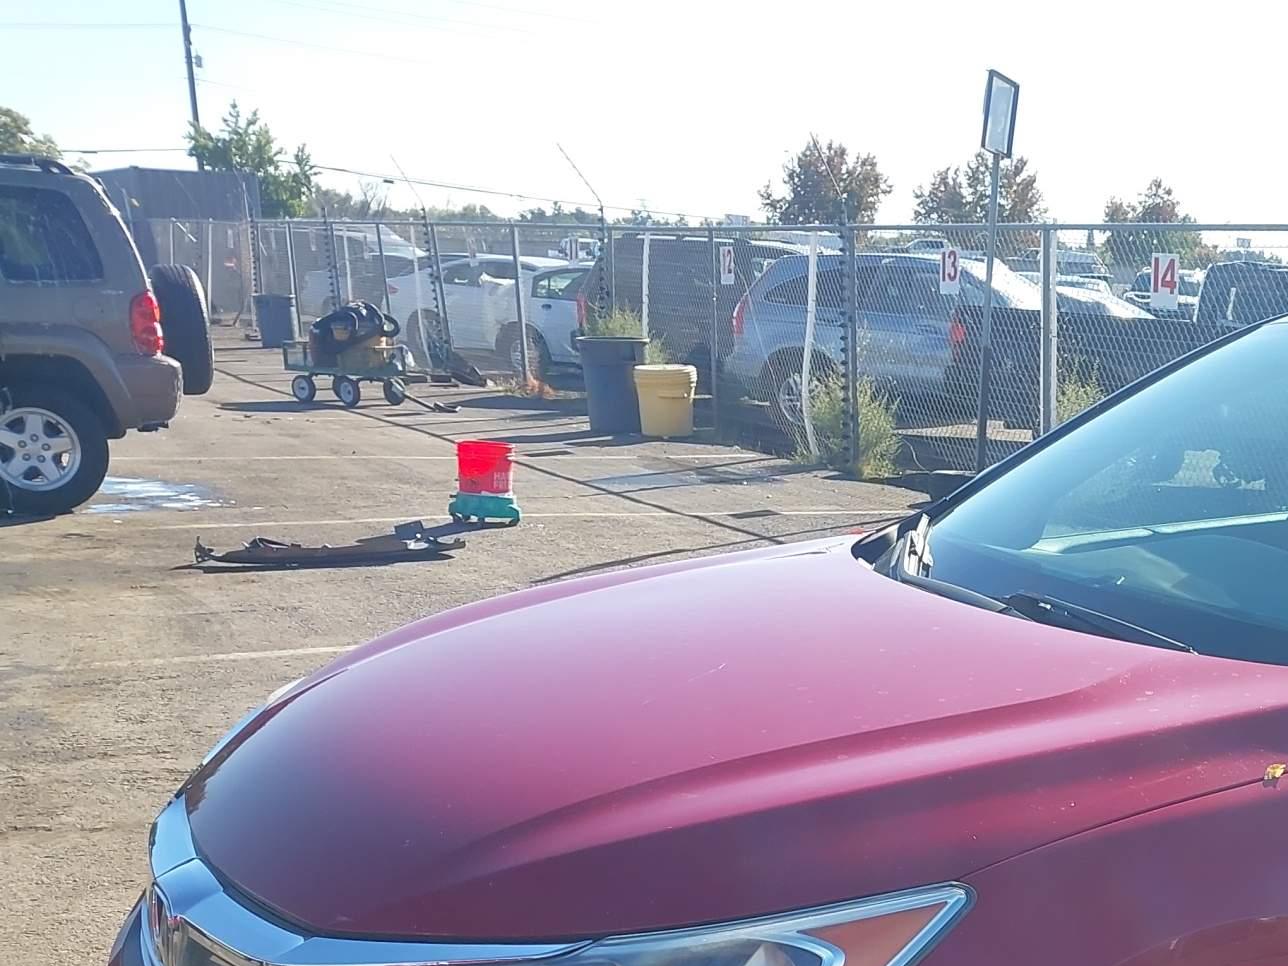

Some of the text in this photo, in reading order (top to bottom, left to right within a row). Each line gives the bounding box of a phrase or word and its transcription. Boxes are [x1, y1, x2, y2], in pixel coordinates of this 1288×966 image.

[722, 248, 733, 274] 12
[942, 249, 958, 282] 13
[1153, 256, 1177, 295] 14
